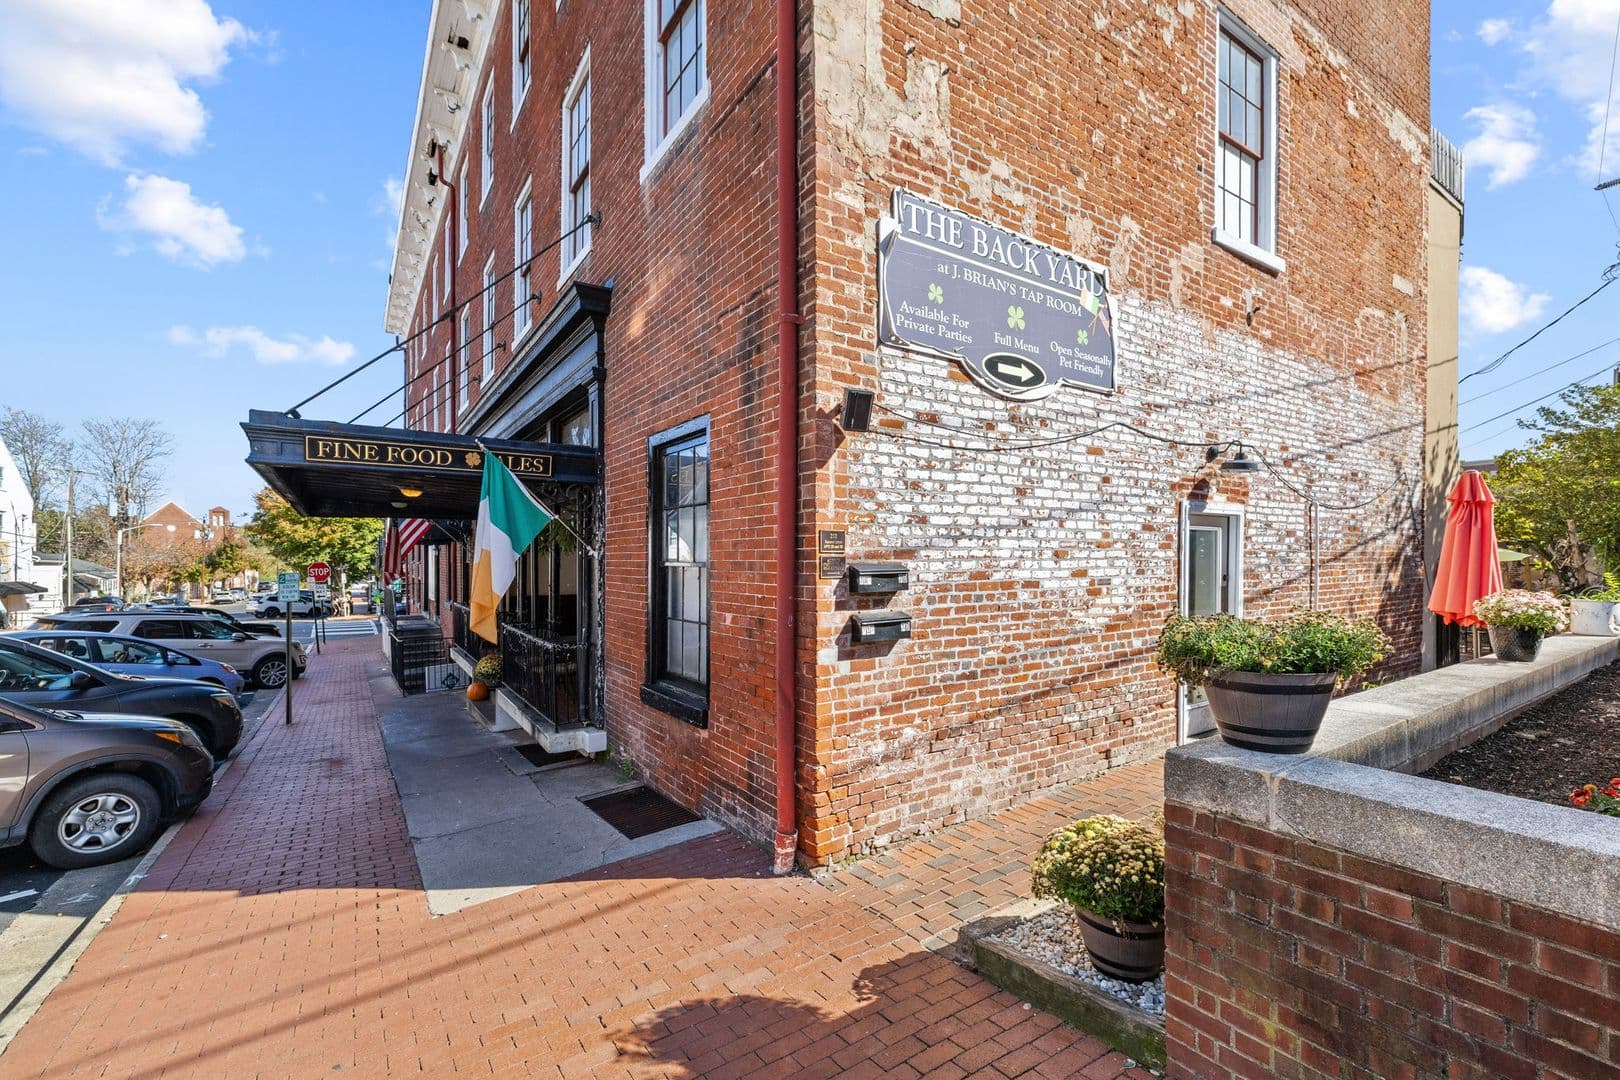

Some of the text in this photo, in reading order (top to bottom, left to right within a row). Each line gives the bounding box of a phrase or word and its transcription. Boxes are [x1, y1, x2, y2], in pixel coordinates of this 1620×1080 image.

[904, 201, 1104, 297] THE BACK YARD
[937, 263, 1082, 317] at J. BRIAN'S TAP ROOM
[896, 313, 973, 344] Private Parties
[900, 300, 970, 329] Available For
[994, 331, 1040, 354] Full Menu
[1050, 341, 1112, 369] Open Seasonally
[1060, 356, 1105, 378] Pet Friendly
[317, 440, 544, 472] FINE FOOD LES
[280, 574, 285, 583] 2
[310, 567, 330, 577] STOP
